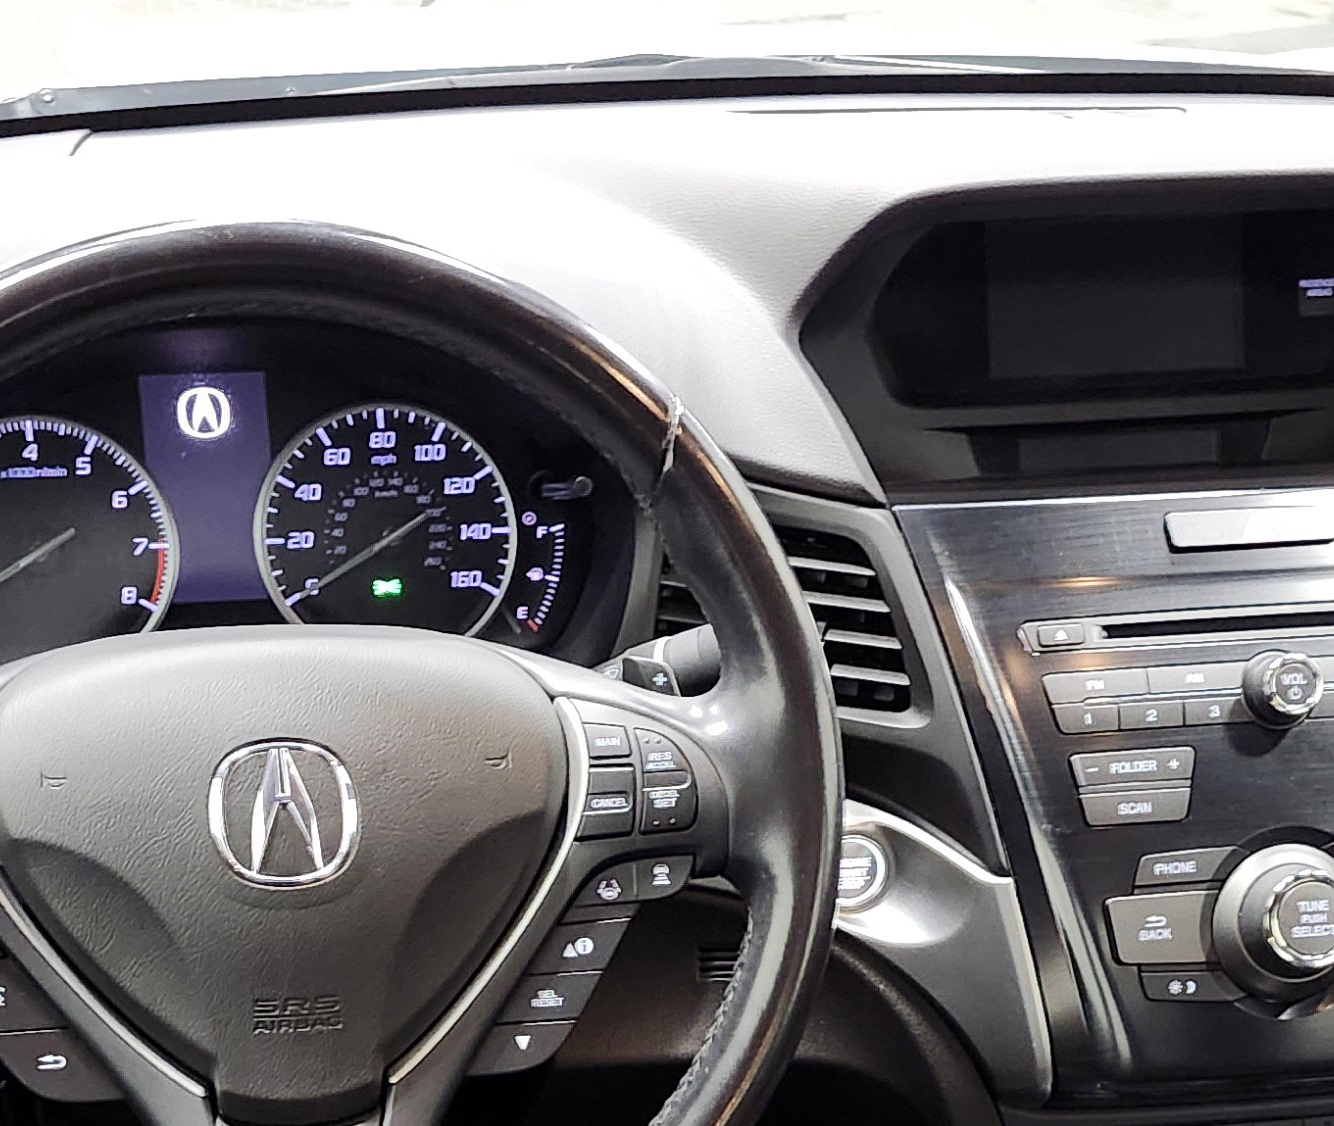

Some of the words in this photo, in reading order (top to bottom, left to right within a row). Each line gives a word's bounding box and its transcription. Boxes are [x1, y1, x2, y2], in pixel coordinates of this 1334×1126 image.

[369, 431, 397, 448] 80
[21, 443, 39, 461] 4
[323, 447, 351, 465] 60
[414, 444, 446, 462] 100
[75, 456, 91, 475] 5
[294, 483, 322, 501] 40
[443, 477, 476, 495] 120
[112, 490, 128, 508] 6
[287, 530, 315, 549] 20
[459, 522, 492, 540] 140
[536, 525, 548, 539] F
[133, 538, 148, 556] 7
[450, 570, 482, 588] 160
[121, 586, 137, 605] 8
[517, 607, 528, 620] E
[1281, 673, 1308, 686] VOL
[1084, 712, 1093, 725] 1
[1145, 708, 1157, 722] 2
[1208, 704, 1221, 718] 3
[1109, 759, 1158, 775] FOLDER
[1117, 801, 1153, 815] SCAN
[1152, 859, 1198, 876] PHONE
[1296, 899, 1331, 913] TUNE
[1137, 925, 1174, 942] BACK
